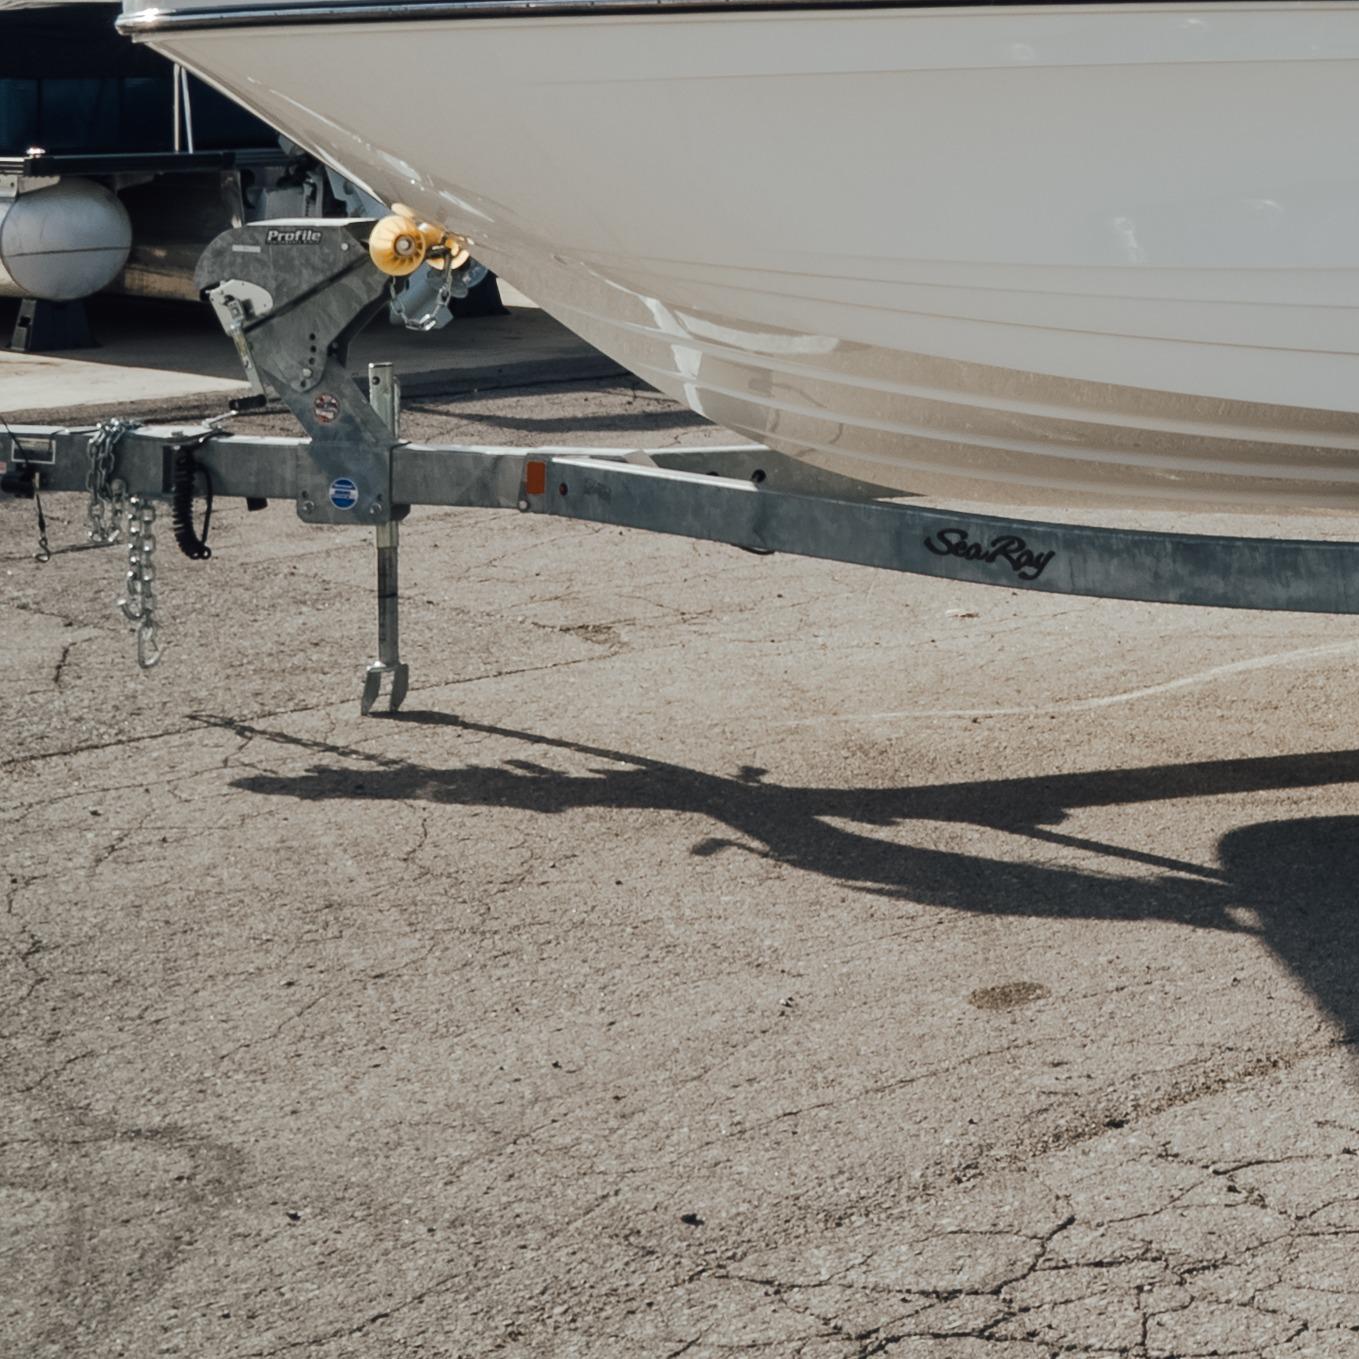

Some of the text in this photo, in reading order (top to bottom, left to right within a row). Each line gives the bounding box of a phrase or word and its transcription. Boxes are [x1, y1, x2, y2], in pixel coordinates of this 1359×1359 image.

[267, 229, 321, 241] Profile
[924, 528, 1055, 580] Sea Ray
